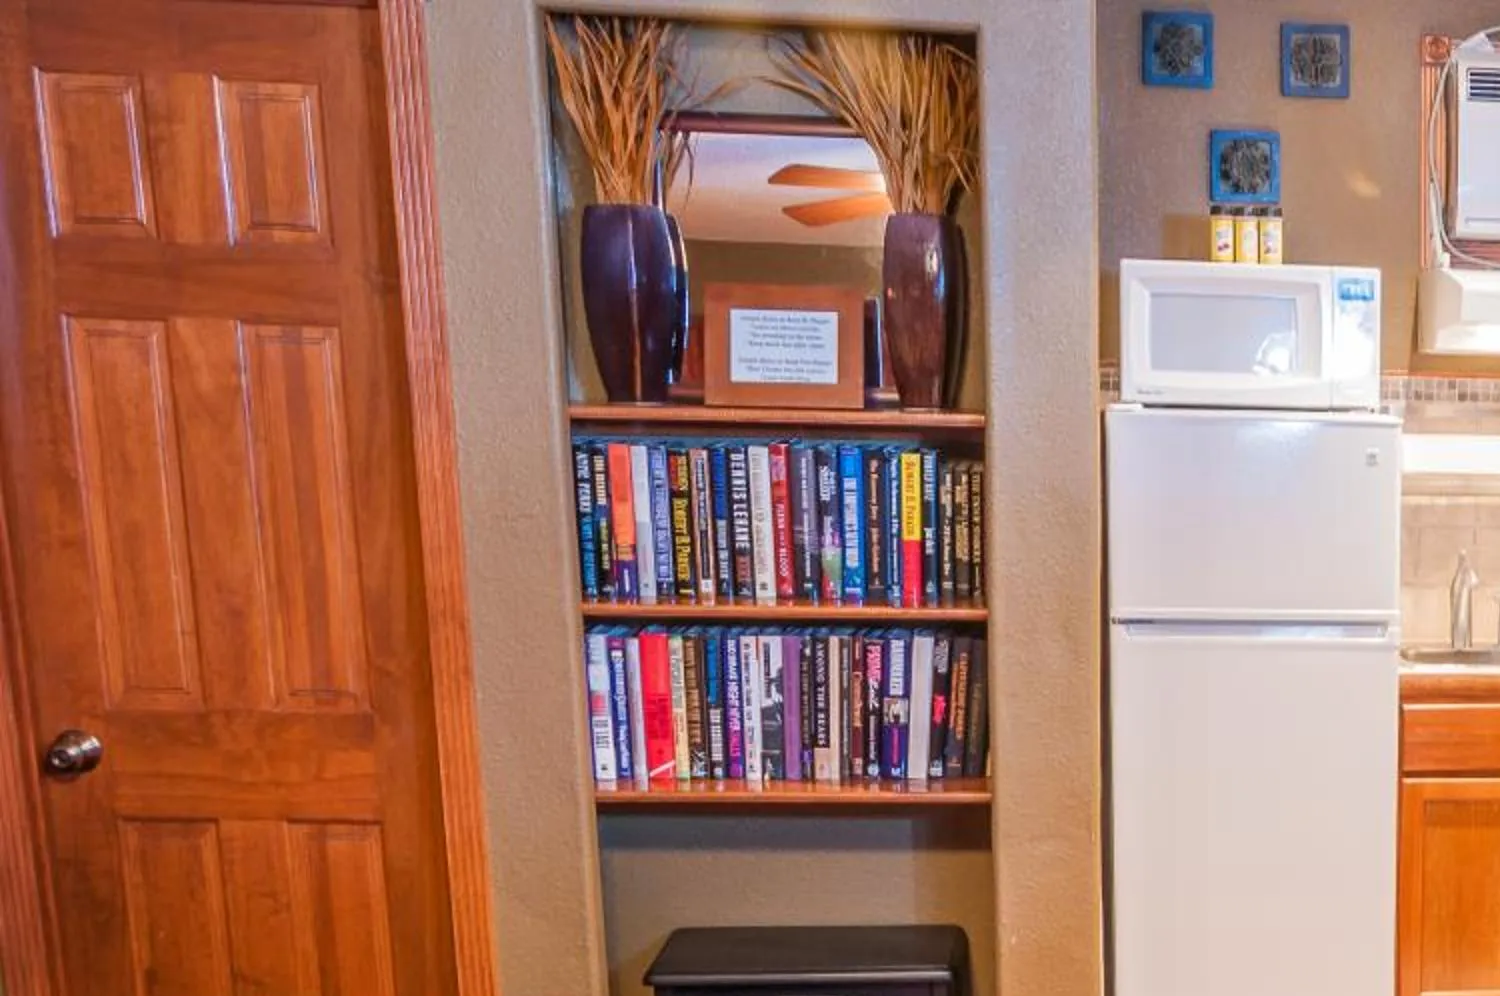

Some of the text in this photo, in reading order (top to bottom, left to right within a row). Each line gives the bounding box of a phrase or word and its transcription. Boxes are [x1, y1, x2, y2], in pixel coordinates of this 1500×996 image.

[730, 453, 747, 500] DENNIS
[733, 503, 750, 549] LEHANE
[815, 642, 825, 683] AMONG
[816, 686, 825, 708] THE
